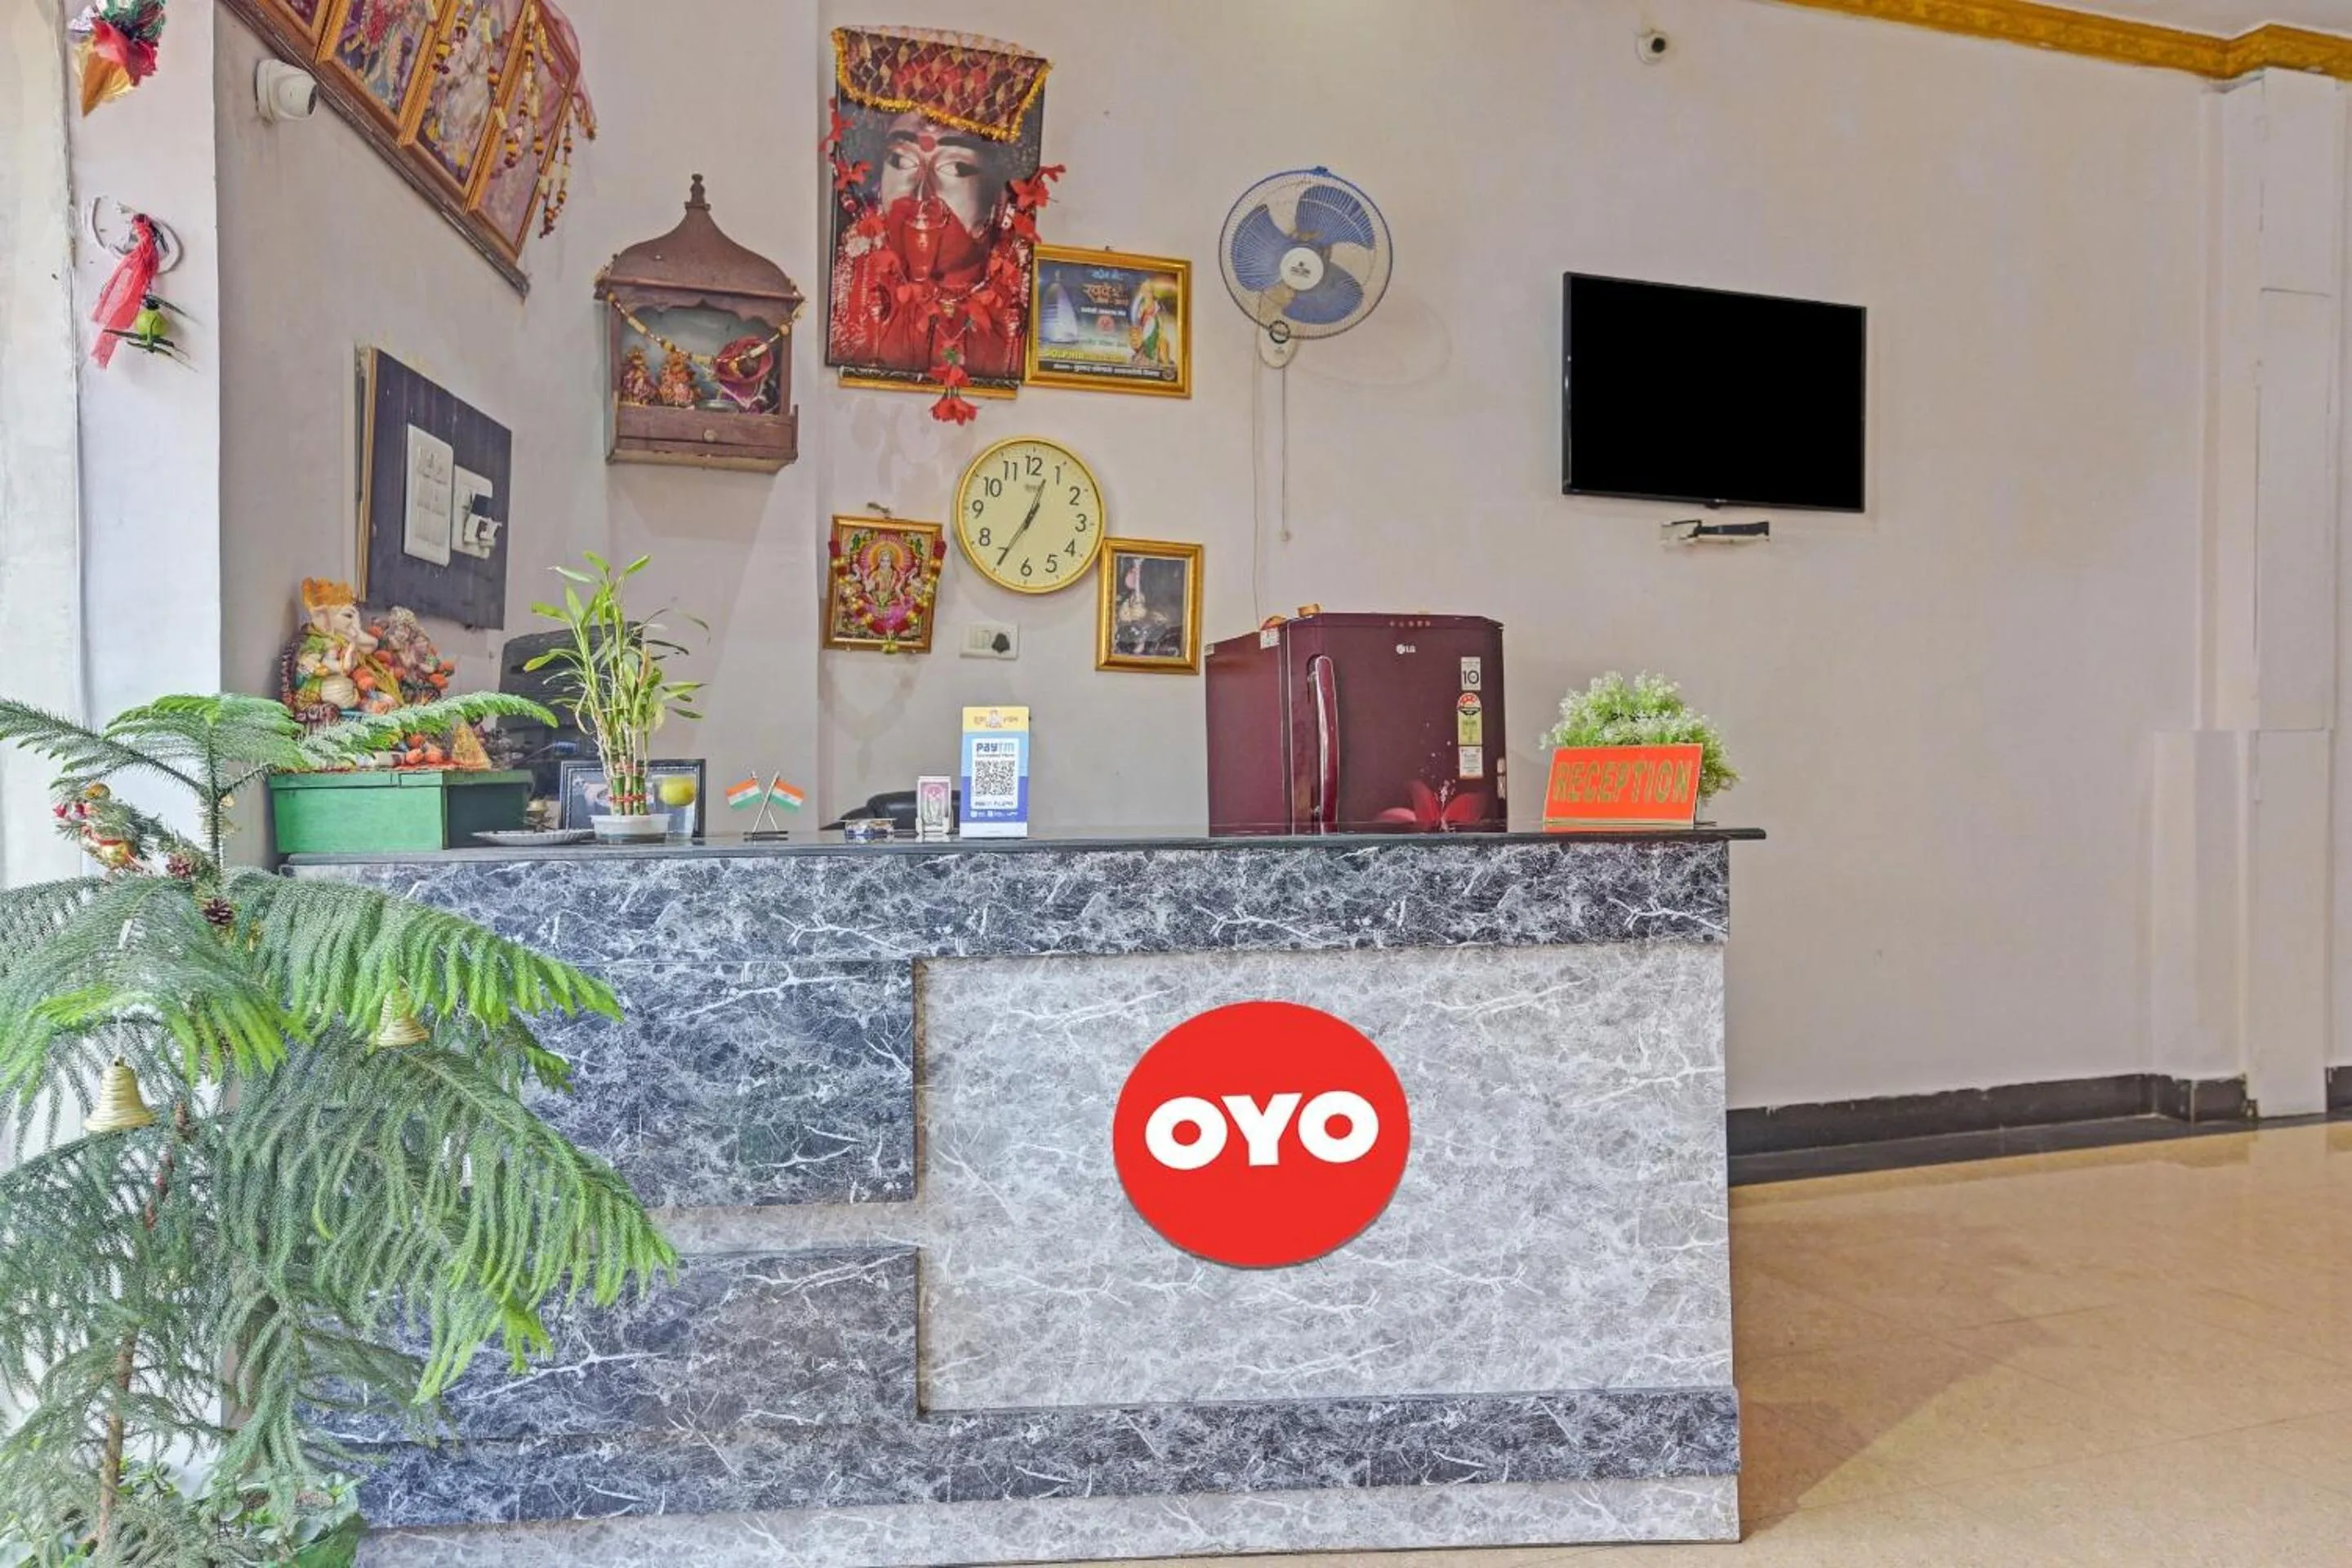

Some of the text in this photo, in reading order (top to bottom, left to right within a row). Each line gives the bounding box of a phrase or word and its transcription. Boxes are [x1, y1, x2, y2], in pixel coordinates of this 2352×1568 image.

[1003, 461, 1018, 481] 11
[1025, 456, 1043, 475] 12
[1054, 466, 1061, 485] 1
[984, 476, 1002, 497] 10
[1069, 486, 1080, 506] 2
[972, 499, 984, 519] 9
[1075, 513, 1087, 532] 3
[978, 528, 991, 546] 8
[996, 546, 1009, 566] 7
[1064, 538, 1076, 557] 4
[1021, 557, 1033, 577] 6
[1045, 554, 1058, 573] 5
[1463, 670, 1479, 684] 10
[1552, 760, 1694, 804] RECEPTION
[1145, 1090, 1379, 1170] OYO
